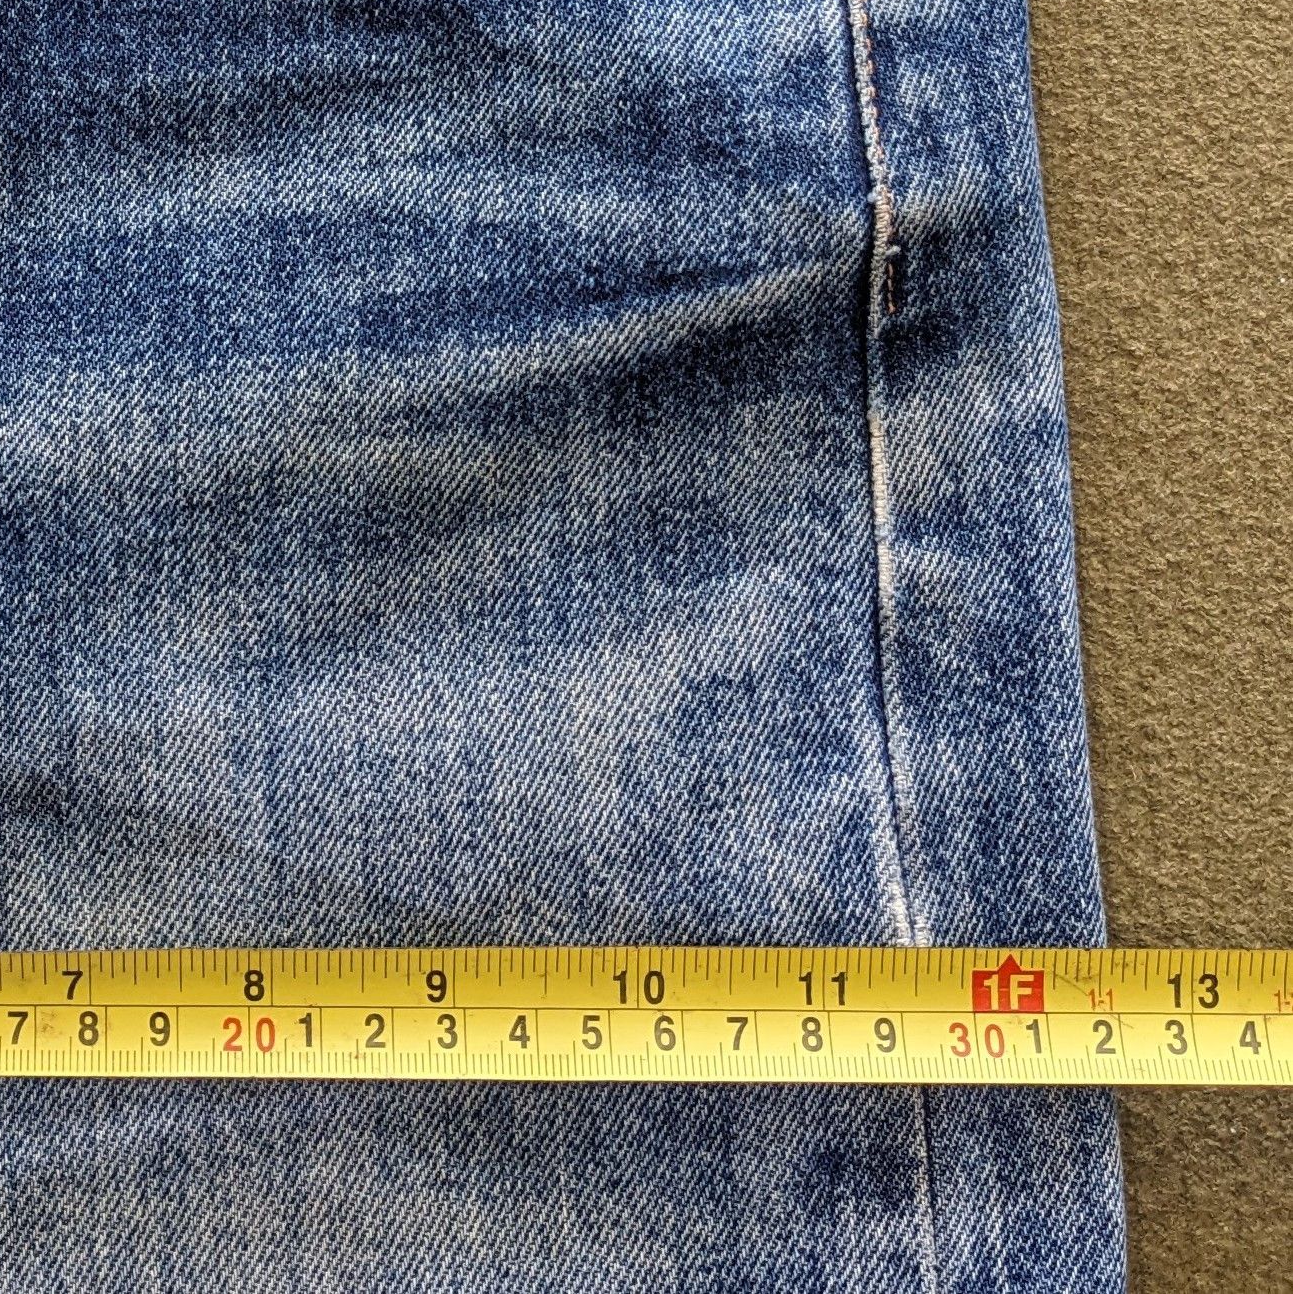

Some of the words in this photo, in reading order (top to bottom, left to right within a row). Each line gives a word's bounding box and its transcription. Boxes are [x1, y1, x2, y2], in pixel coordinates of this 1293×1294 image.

[61, 970, 84, 1000] 7
[244, 969, 265, 1001] 8
[425, 969, 448, 1002] 9
[612, 970, 666, 1005] 10
[798, 971, 847, 1006] 11
[982, 972, 1035, 1010] 1F
[1167, 973, 1220, 1009] 13
[7, 1011, 29, 1045] 7
[78, 1011, 100, 1046] 8
[149, 1012, 171, 1046] 9
[222, 1016, 276, 1053] 20
[298, 1013, 314, 1048] 1
[364, 1014, 387, 1049] 2
[437, 1014, 459, 1049] 3
[508, 1014, 531, 1049] 4
[581, 1015, 603, 1050] 5
[653, 1015, 676, 1051] 6
[726, 1016, 749, 1051] 7
[801, 1017, 823, 1052] 8
[874, 1017, 897, 1053] 9
[948, 1021, 1005, 1058] 30
[1025, 1018, 1043, 1055] 1
[1092, 1019, 1116, 1054] 2
[1165, 1019, 1188, 1055] 3
[1239, 1020, 1262, 1055] 4
